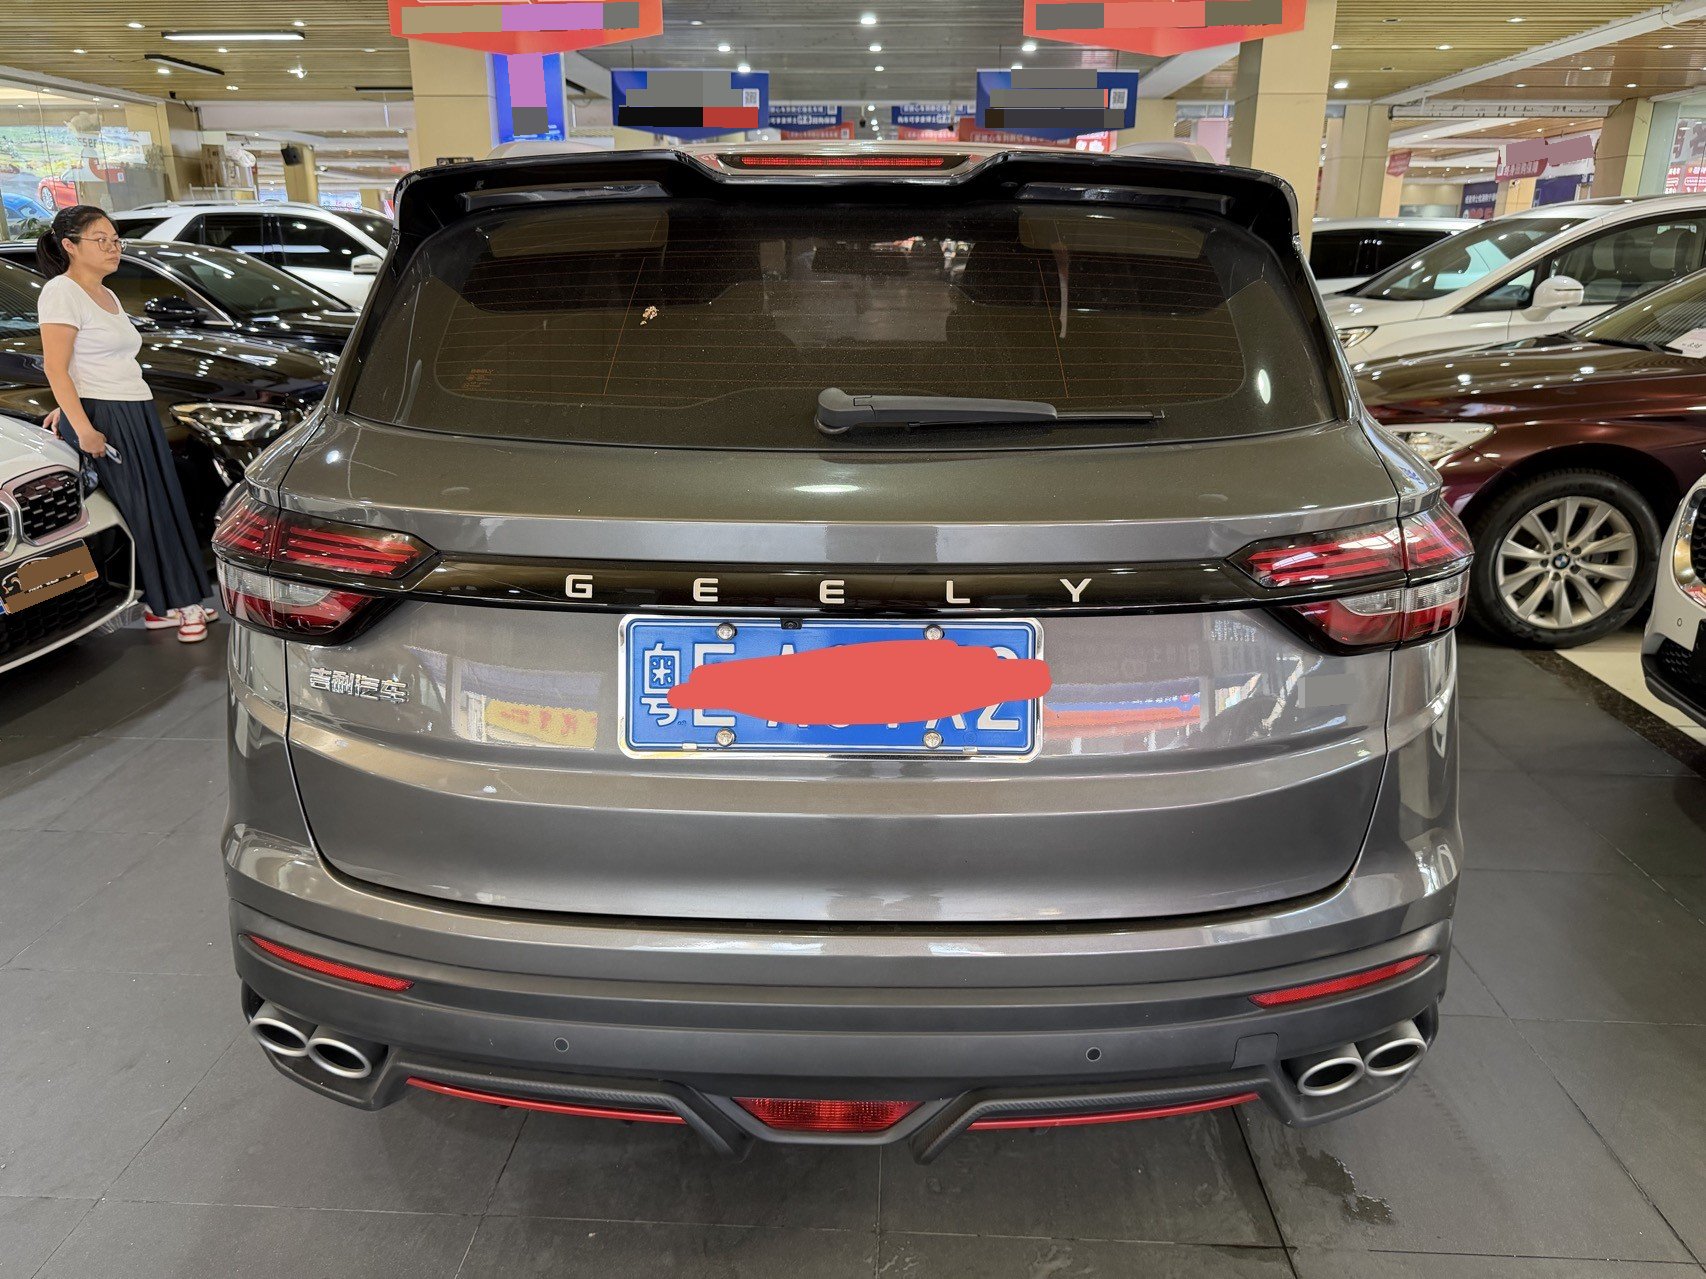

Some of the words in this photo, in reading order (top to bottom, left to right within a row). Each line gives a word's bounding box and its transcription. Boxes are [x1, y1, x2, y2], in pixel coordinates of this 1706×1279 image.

[565, 574, 1092, 604] GEELY
[310, 667, 408, 703] 吉利汽车
